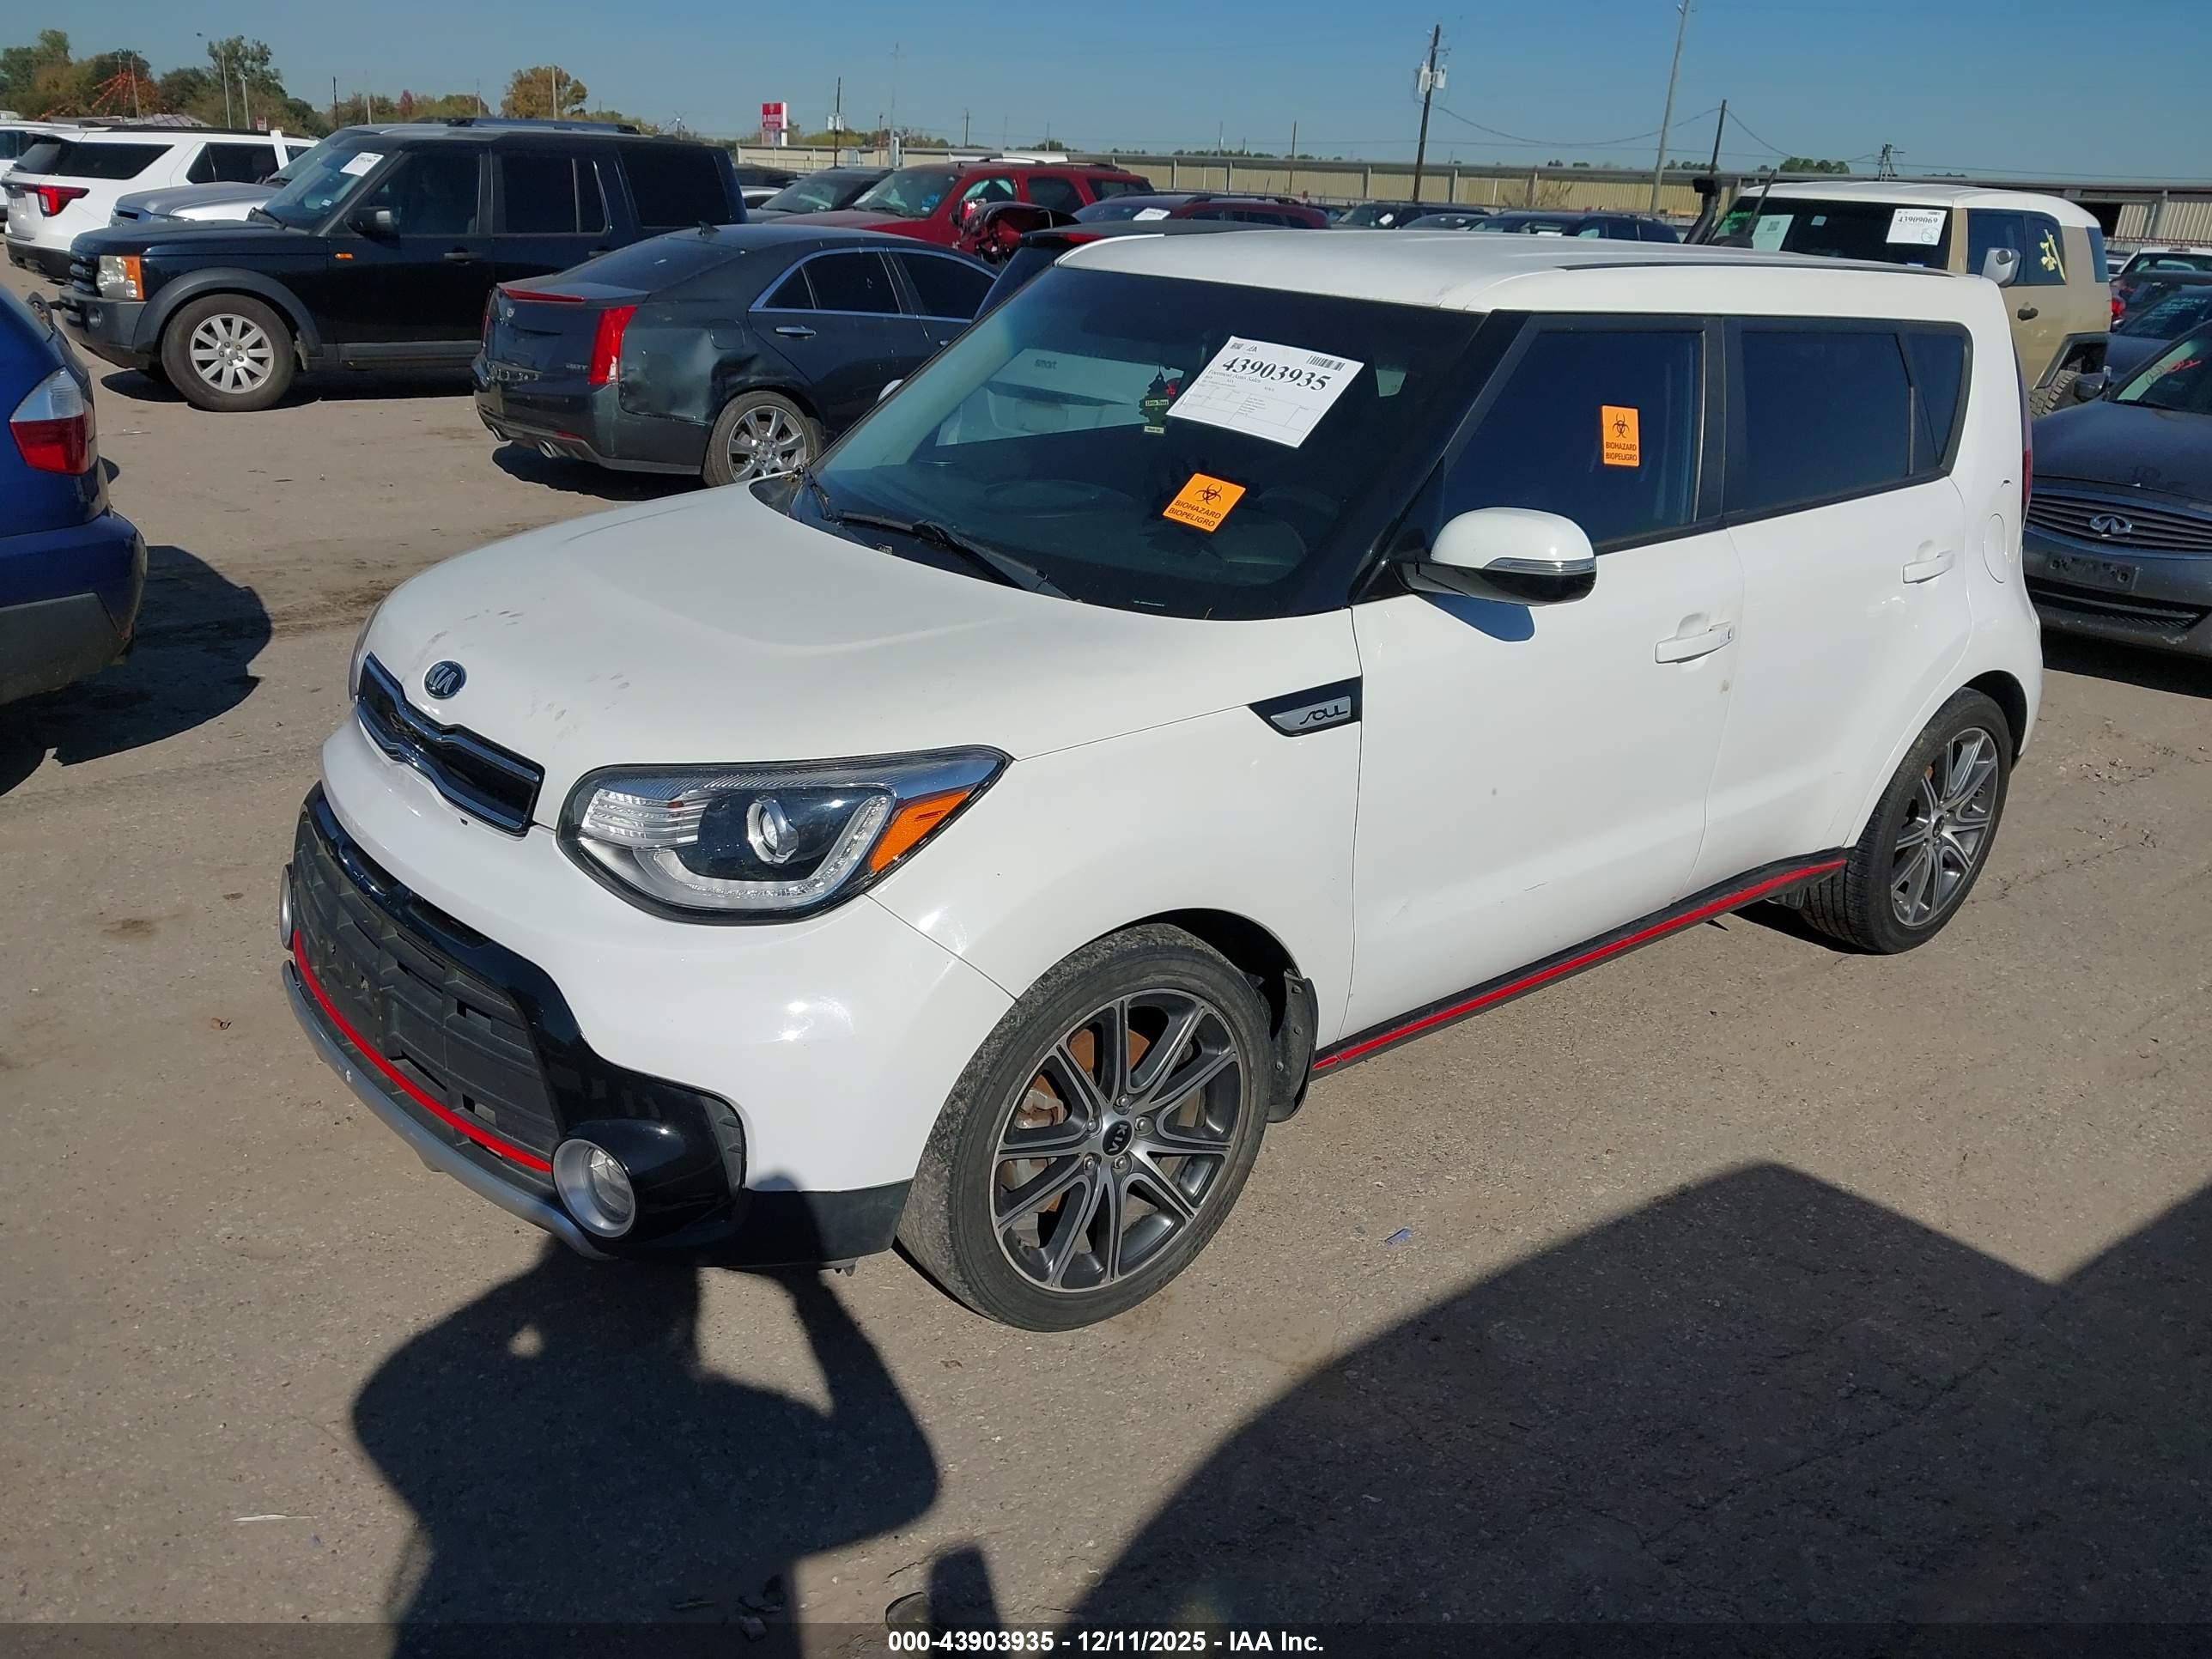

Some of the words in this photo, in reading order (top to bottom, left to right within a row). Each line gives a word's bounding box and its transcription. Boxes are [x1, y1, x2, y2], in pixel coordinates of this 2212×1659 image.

[1222, 356, 1332, 391] 43903935
[1606, 441, 1637, 451] BIOHAZARD
[1606, 453, 1637, 461] BIOPELIGRO
[1168, 507, 1215, 526] BIOPELIGRO
[1174, 500, 1222, 520] BIOHAZARD
[1108, 1124, 1128, 1152] KIA
